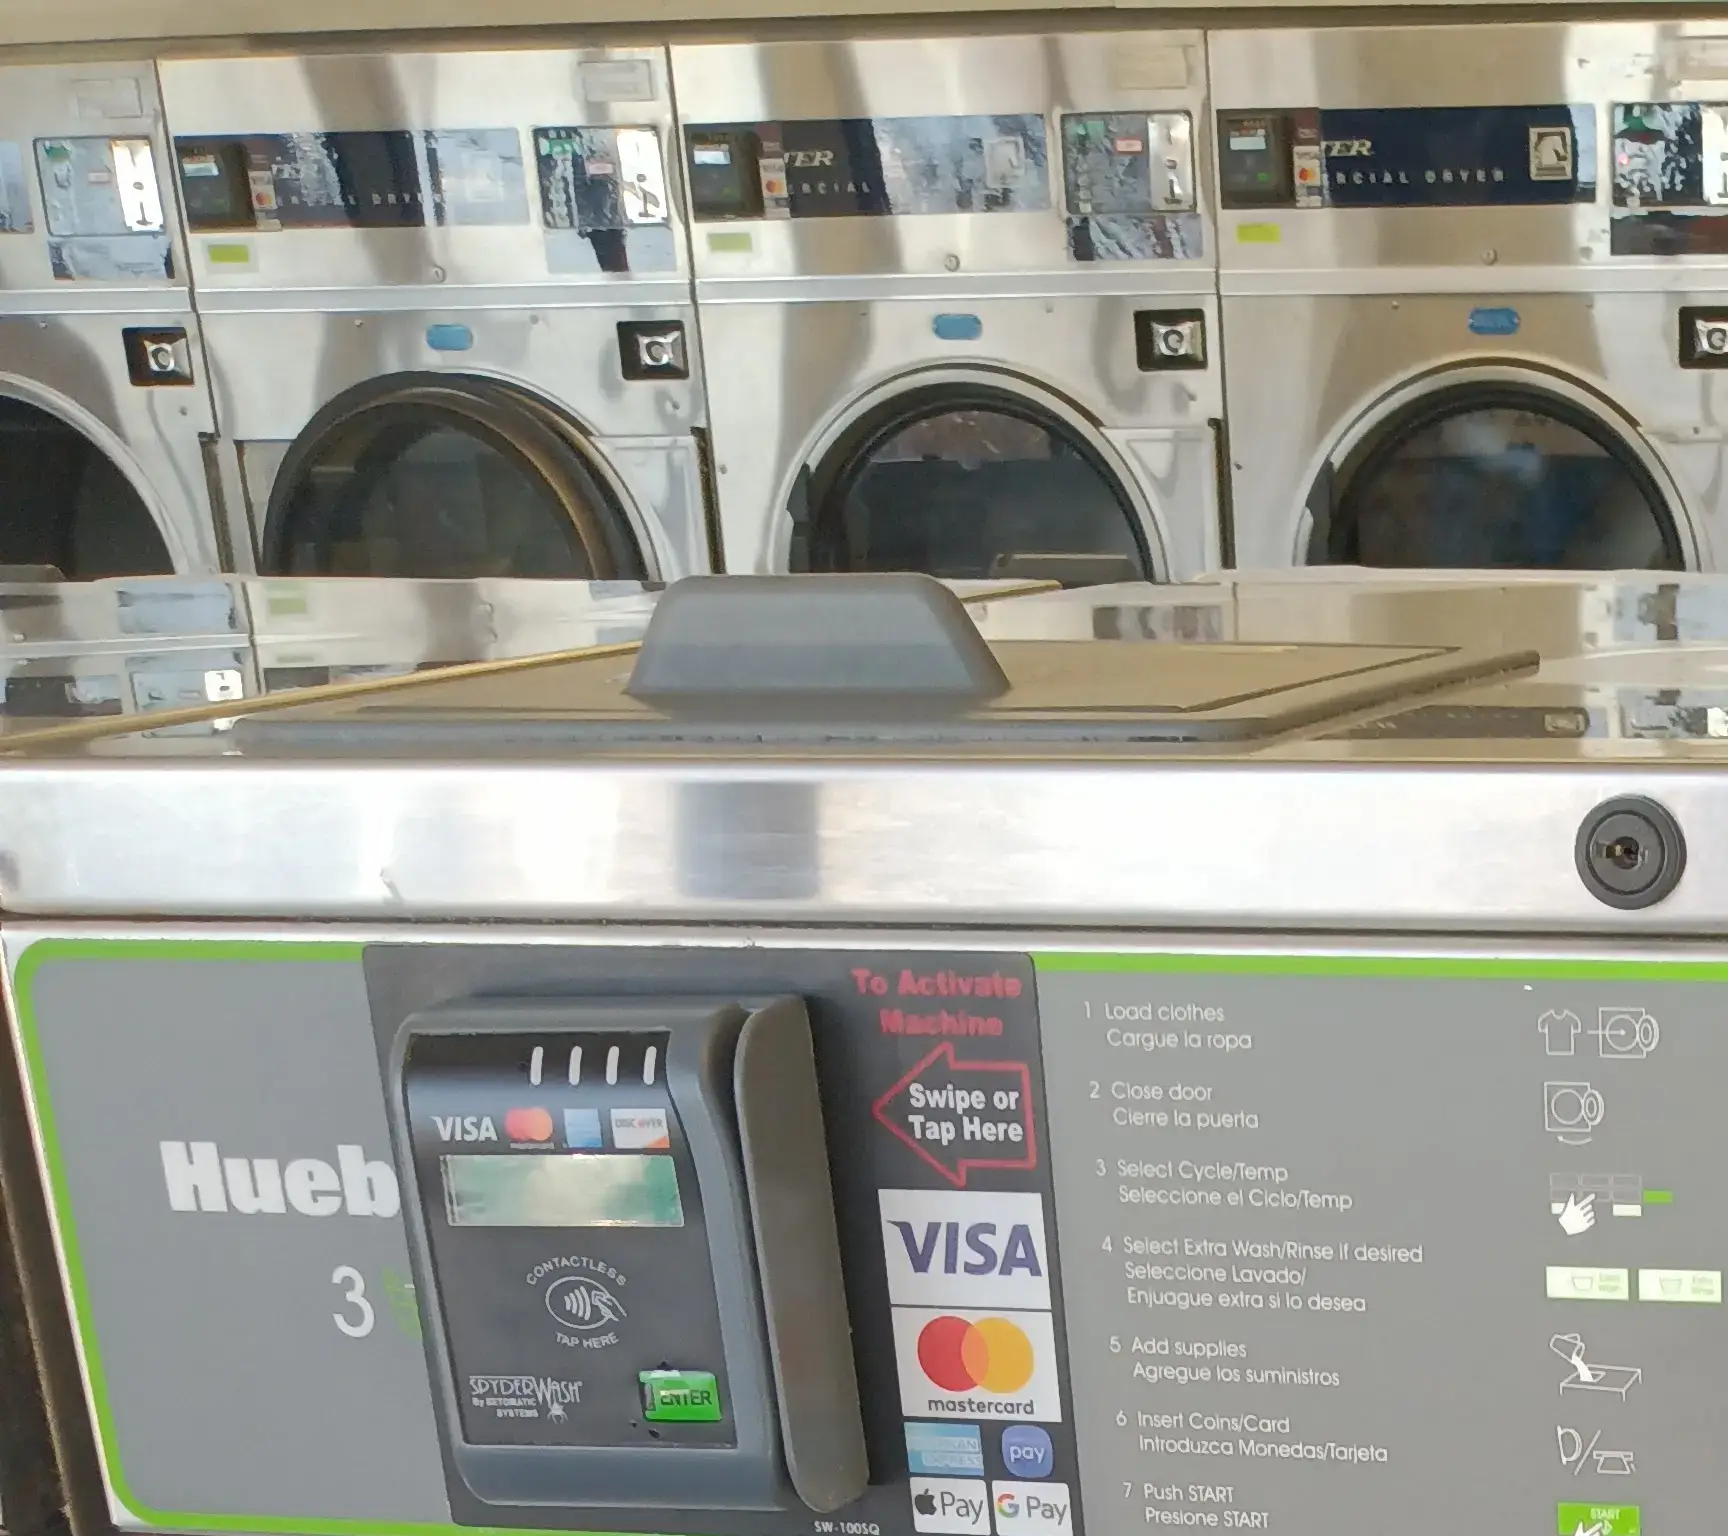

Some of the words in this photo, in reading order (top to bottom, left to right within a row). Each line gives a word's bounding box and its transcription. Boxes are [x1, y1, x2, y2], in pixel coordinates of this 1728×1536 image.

[851, 968, 888, 995] To
[897, 968, 1023, 998] Activate
[879, 1008, 1004, 1037] Machine
[1084, 1001, 1091, 1019] 1
[1104, 1001, 1153, 1021] Load
[1157, 1002, 1226, 1022] clothes
[1106, 1028, 1179, 1052] Cargue
[1184, 1029, 1202, 1048] la
[1207, 1033, 1253, 1052] ropa
[908, 1083, 986, 1115] Swipe
[993, 1090, 1020, 1110] or
[1089, 1080, 1101, 1100] 2
[1111, 1081, 1164, 1100] Close
[1168, 1082, 1213, 1102] door
[430, 1115, 499, 1142] VISA
[908, 1115, 956, 1146] Tap
[962, 1115, 1024, 1142] Here
[1113, 1106, 1169, 1127] Cierre
[1173, 1108, 1192, 1128] la
[1196, 1110, 1260, 1131] puerta
[160, 1140, 401, 1219] Hueb
[1095, 1158, 1107, 1178] 3
[1117, 1158, 1173, 1179] Select
[1178, 1160, 1289, 1185] Cycle/Temp
[1119, 1184, 1222, 1206] Seleccione
[1226, 1188, 1244, 1207] el
[1248, 1188, 1353, 1213] Ciclo/Temp
[886, 1219, 1043, 1277] VISA
[1101, 1236, 1113, 1254] 4
[1123, 1236, 1179, 1256] Select
[1184, 1238, 1228, 1257] Extra
[1231, 1240, 1334, 1262] Wash/Rinse
[1353, 1244, 1424, 1263] desired
[526, 1255, 628, 1286] CONTACTLESS
[1125, 1262, 1227, 1283] Seleccione
[1232, 1264, 1307, 1286] Lavado/
[1127, 1286, 1213, 1310] Enjuague
[1218, 1291, 1264, 1309] extra
[1268, 1291, 1281, 1309] si
[1285, 1292, 1303, 1310] lo
[1307, 1293, 1367, 1312] desea
[555, 1331, 581, 1348] TAP
[582, 1331, 620, 1350] HERE
[1110, 1336, 1122, 1354] 5
[1131, 1337, 1170, 1356] Add
[1174, 1341, 1248, 1360] supplies
[1133, 1362, 1212, 1385] Agregue
[1217, 1364, 1241, 1383] los
[1245, 1366, 1341, 1387] suministros
[660, 1389, 713, 1406] ENTER
[928, 1398, 1036, 1416] mastercard
[1116, 1409, 1127, 1427] 6
[1137, 1411, 1184, 1430] Insert
[1188, 1412, 1291, 1434] Coins/Card
[1010, 1443, 1046, 1464] pay
[1139, 1435, 1234, 1457] Introduzca
[1238, 1438, 1389, 1464] Monedas/Tarjeta
[1123, 1482, 1132, 1499] 7
[1143, 1483, 1184, 1502] Push
[1188, 1484, 1235, 1504] START
[940, 1491, 984, 1526] Pay
[1026, 1496, 1068, 1527] Pay
[1145, 1506, 1219, 1528] Presione
[1223, 1509, 1270, 1529] START
[1590, 1507, 1622, 1521] START
